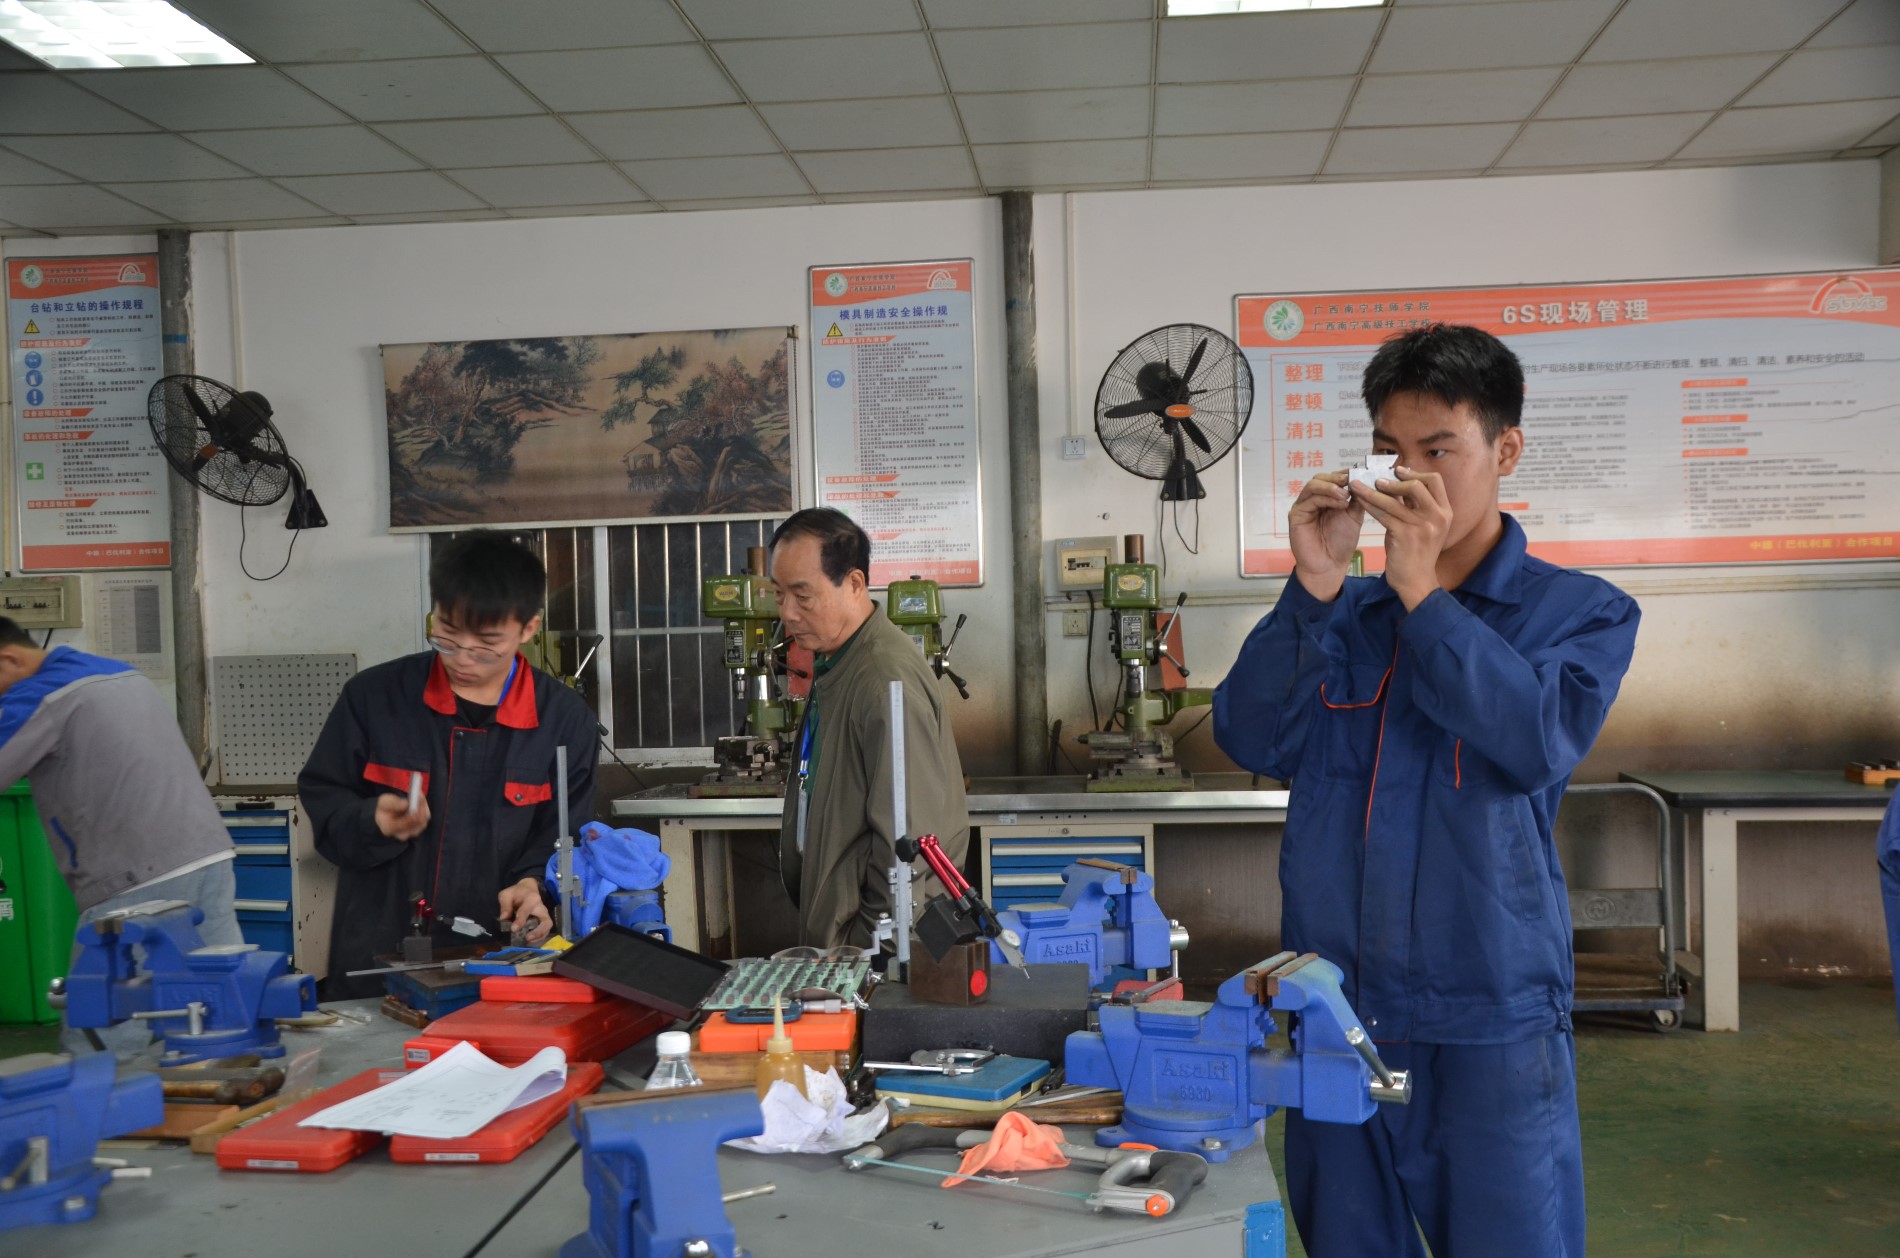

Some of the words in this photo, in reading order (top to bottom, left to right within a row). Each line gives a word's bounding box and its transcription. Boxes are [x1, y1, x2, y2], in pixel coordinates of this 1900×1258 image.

[30, 299, 144, 314] 台钻和立钻的操作规程
[839, 304, 948, 321] 模具制造安全操作规
[1313, 301, 1430, 315] 广西南宁技师学院
[1502, 299, 1649, 325] 6S现场管理
[1285, 364, 1324, 382] 整理
[1286, 392, 1323, 411] 整顿
[1286, 422, 1324, 440] 清扫
[1287, 450, 1324, 469] 清洁
[1043, 938, 1092, 957] Asaki
[1161, 1057, 1230, 1081] Asaki
